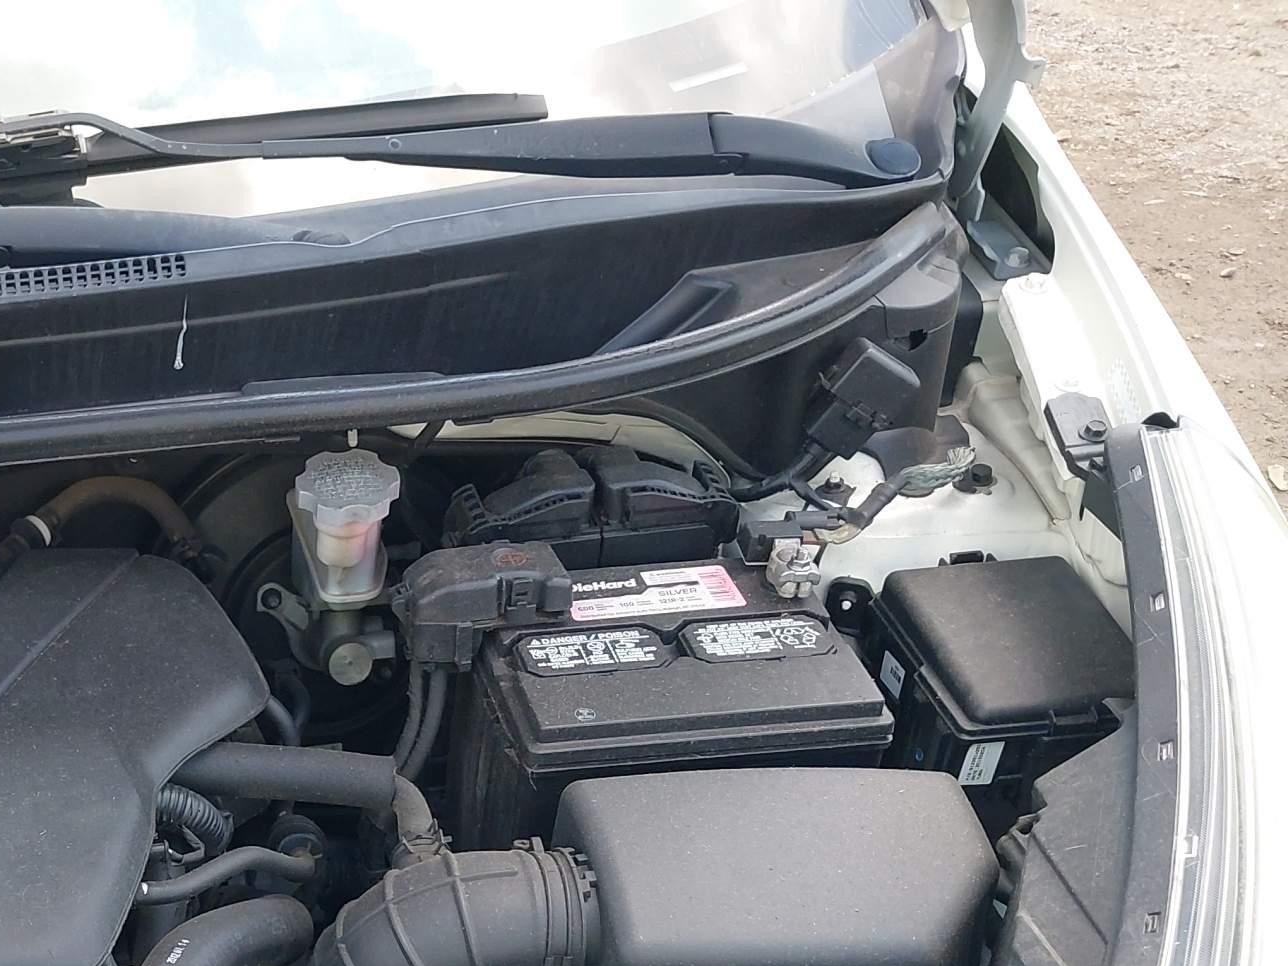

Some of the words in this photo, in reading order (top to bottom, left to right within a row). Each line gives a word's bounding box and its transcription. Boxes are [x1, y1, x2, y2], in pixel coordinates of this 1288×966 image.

[658, 587, 697, 597] SILVER
[540, 634, 588, 646] DANGER
[598, 630, 640, 641] POISON
